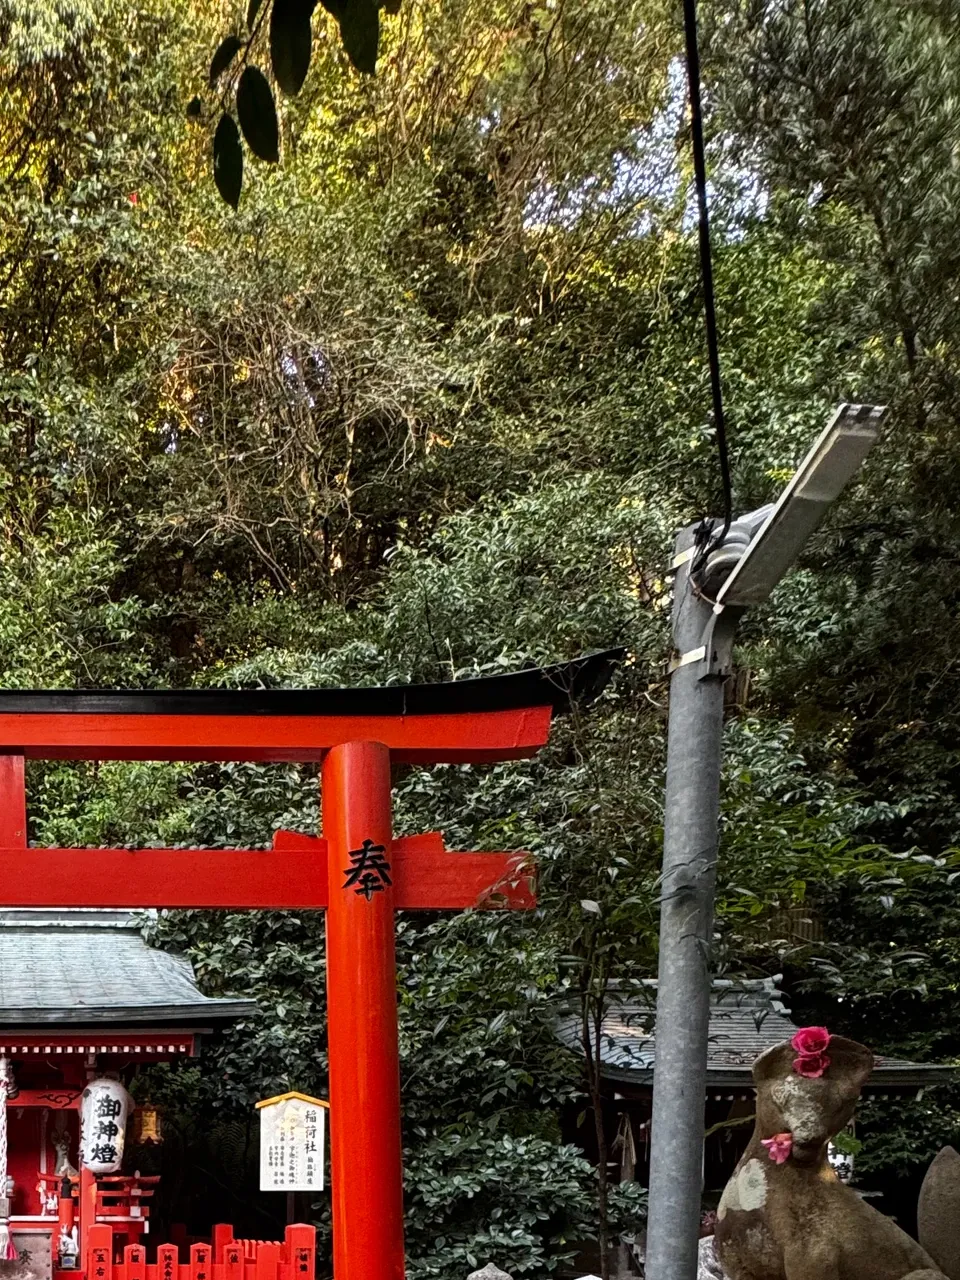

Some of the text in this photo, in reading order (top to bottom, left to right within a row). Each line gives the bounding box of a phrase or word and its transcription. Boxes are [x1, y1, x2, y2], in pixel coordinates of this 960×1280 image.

[341, 839, 393, 902] 奉
[91, 1094, 122, 1164] 御神燈
[304, 1109, 317, 1154] 稲荷社
